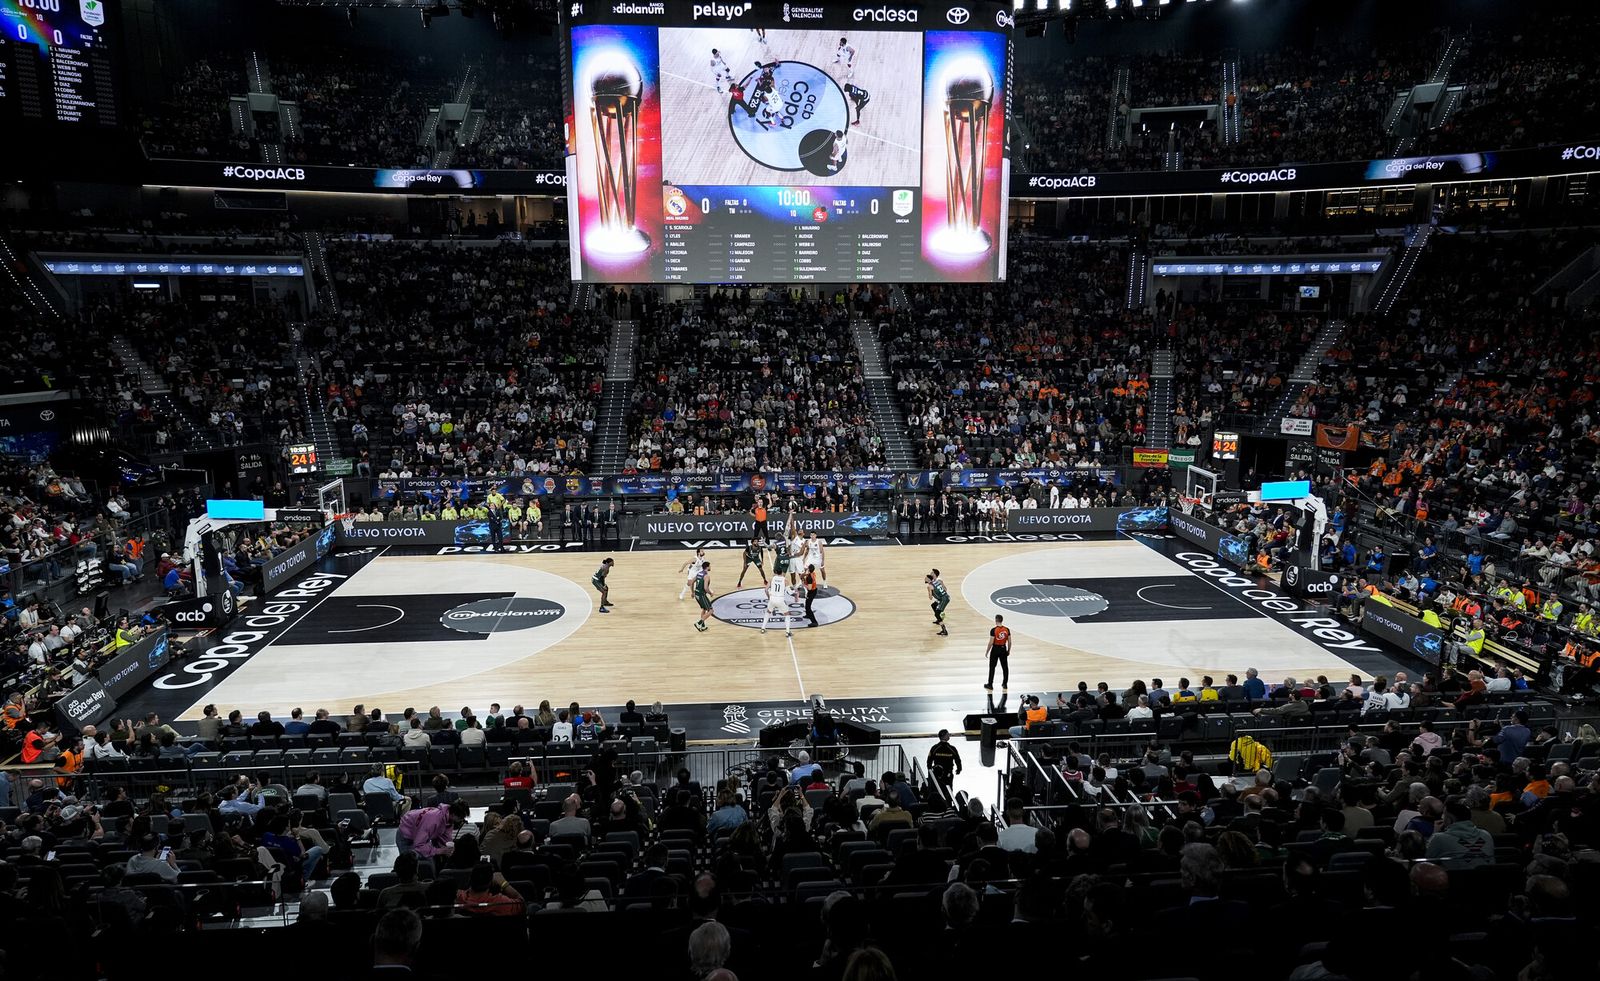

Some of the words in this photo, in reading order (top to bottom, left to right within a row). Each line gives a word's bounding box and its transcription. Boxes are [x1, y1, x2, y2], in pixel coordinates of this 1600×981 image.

[693, 2, 743, 20] pelayo
[853, 6, 918, 22] endesa
[18, 24, 27, 40] 0
[54, 29, 63, 45] 0
[223, 165, 305, 181] #CopaACB
[1385, 162, 1412, 173] Copa
[1425, 161, 1445, 171] Rey
[391, 173, 416, 184] Copa
[426, 174, 442, 184] Rey
[1029, 176, 1096, 190] #CopaACB
[1220, 168, 1297, 184] #CopaACB
[777, 190, 810, 206] 10:00
[702, 198, 710, 214] 0
[870, 199, 879, 215] 0
[1223, 441, 1237, 452] 24
[292, 454, 308, 465] 24
[1290, 453, 1312, 461] SALIDA
[240, 461, 263, 470] SALIDA
[1053, 515, 1092, 523] TOYOTA
[382, 527, 426, 537] TOYOTA
[648, 522, 694, 533] NUEVO
[698, 521, 749, 532] TOYOTA
[1186, 522, 1207, 540] TOYOTA
[946, 534, 1084, 542] endesa
[287, 550, 306, 571] TOYOTA
[275, 572, 348, 598] Rey
[775, 584, 781, 592] 11
[1308, 581, 1333, 593] acb
[999, 595, 1101, 604] mediolanum
[1175, 552, 1258, 587] Copa
[1242, 590, 1317, 614] del
[1290, 617, 1383, 652] Rey
[175, 609, 206, 621] acb
[246, 600, 308, 627] del
[453, 610, 560, 619] mediolanum
[1384, 619, 1404, 634] TOYOTA
[152, 631, 270, 690] Copa
[121, 661, 140, 676] TOYOTA
[68, 701, 88, 718] Copa
[91, 689, 106, 702] Rey
[68, 699, 80, 709] acb
[757, 706, 889, 718] GENEALITAT
